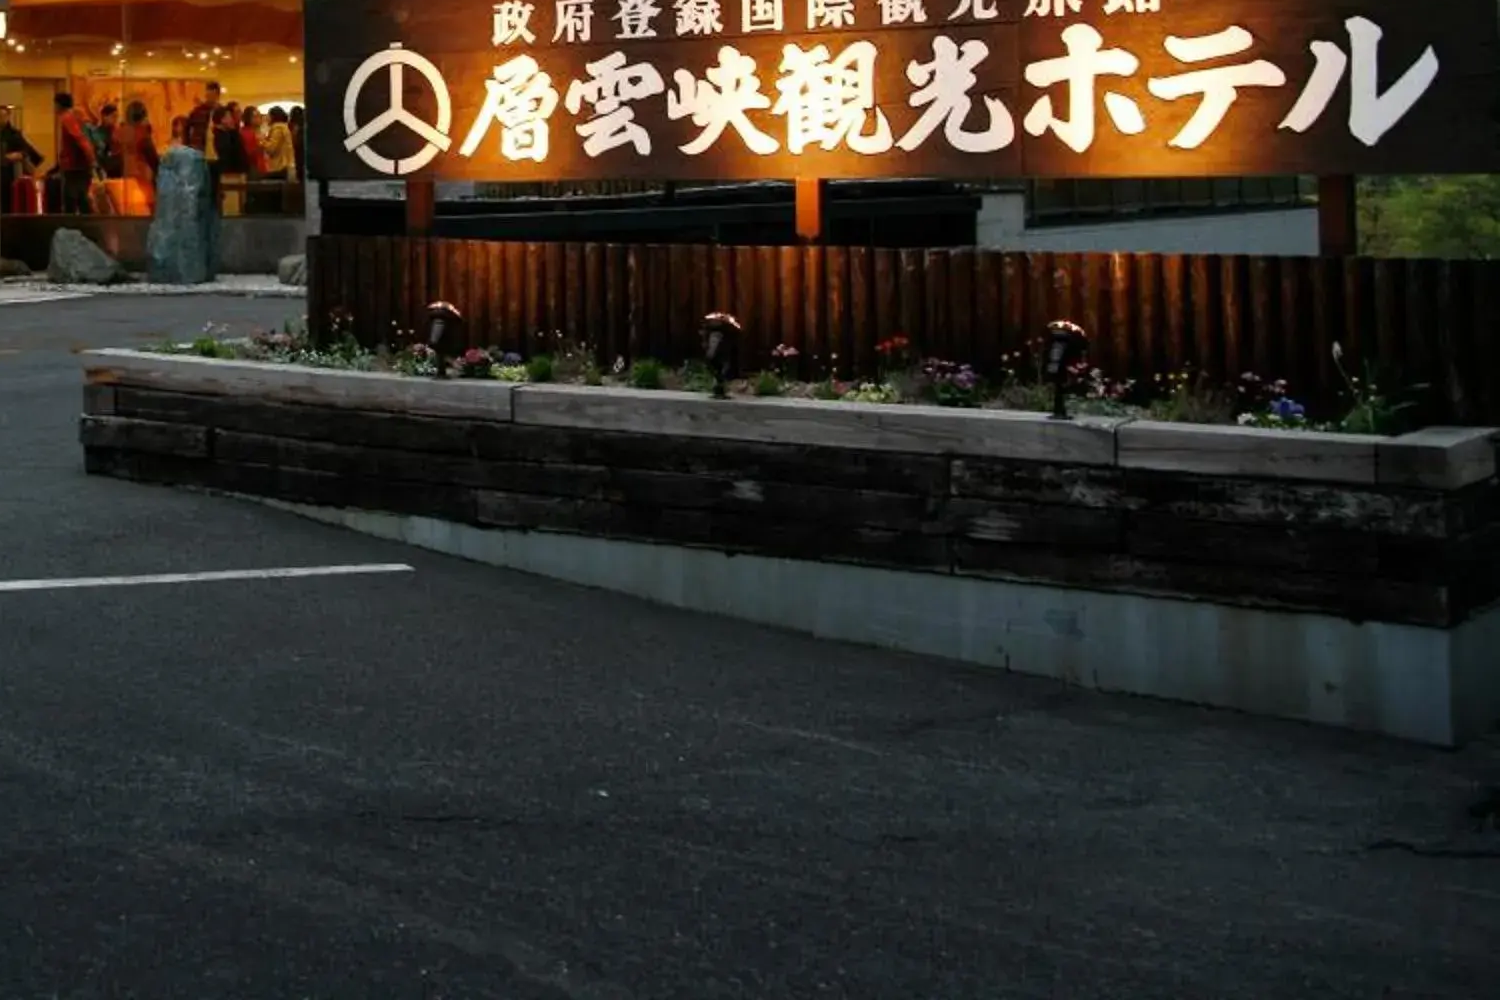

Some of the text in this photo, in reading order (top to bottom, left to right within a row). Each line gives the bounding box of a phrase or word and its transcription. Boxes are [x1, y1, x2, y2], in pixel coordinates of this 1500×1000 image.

[459, 15, 1439, 162] 層雲峡観光ホテル
